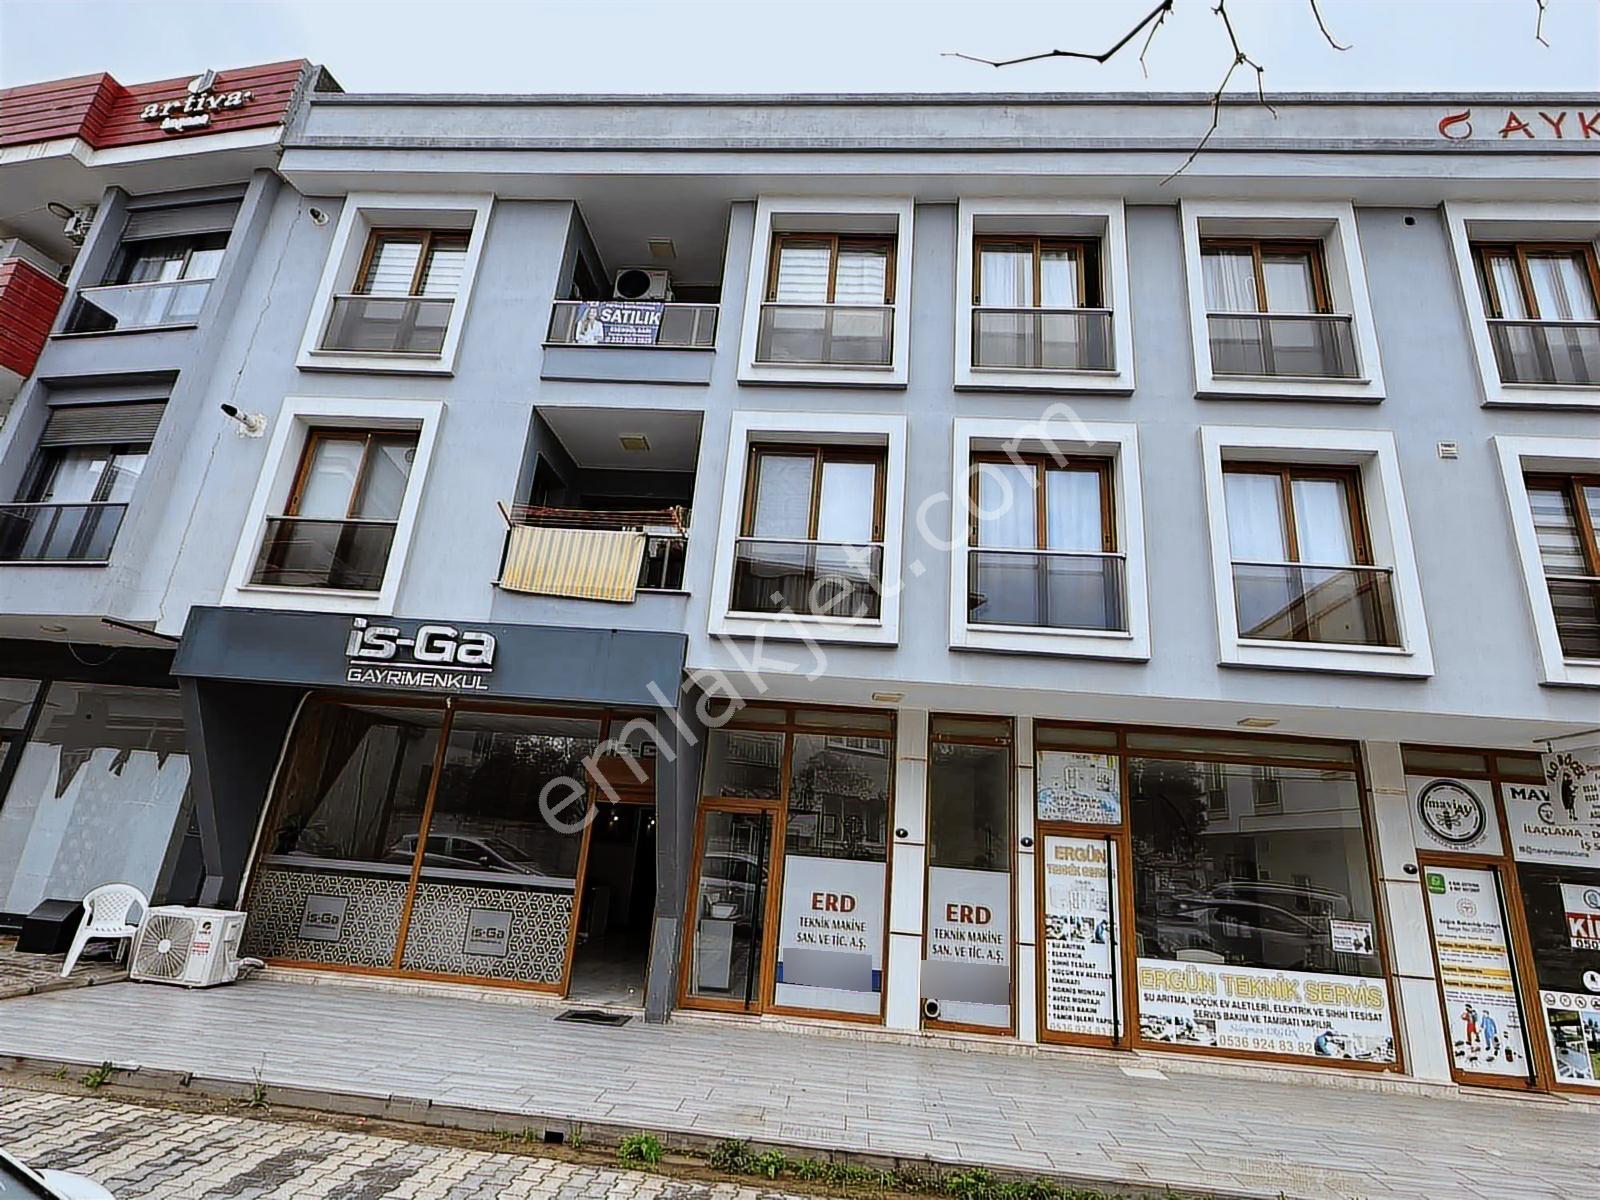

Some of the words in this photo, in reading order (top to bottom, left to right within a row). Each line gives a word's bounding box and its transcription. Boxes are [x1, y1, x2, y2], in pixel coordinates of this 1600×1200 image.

[600, 308, 661, 325] SATILIK
[812, 893, 856, 913] ERD
[800, 916, 830, 929] TEKNİK
[832, 918, 866, 932] MAKİNE
[946, 903, 991, 925] ERD
[935, 928, 966, 941] TEKNİK
[967, 931, 1003, 944] MAKİNE
[1139, 964, 1218, 997] ERGÜN
[1219, 971, 1301, 1003] TEKNİK
[1303, 979, 1385, 1011] SERVİS
[1143, 993, 1155, 1002] SU
[1190, 996, 1218, 1009] KÜÇÜK
[1219, 1000, 1230, 1008] EV
[1273, 1003, 1312, 1016] ELEKTRİK
[1313, 1008, 1325, 1017] VE
[1223, 1012, 1249, 1022] BAKIM
[1251, 1014, 1263, 1024] VE
[1220, 1033, 1249, 1048] 0536
[1252, 1037, 1275, 1050] 924
[1279, 1040, 1294, 1052] 83
[1298, 1042, 1313, 1054] 82
